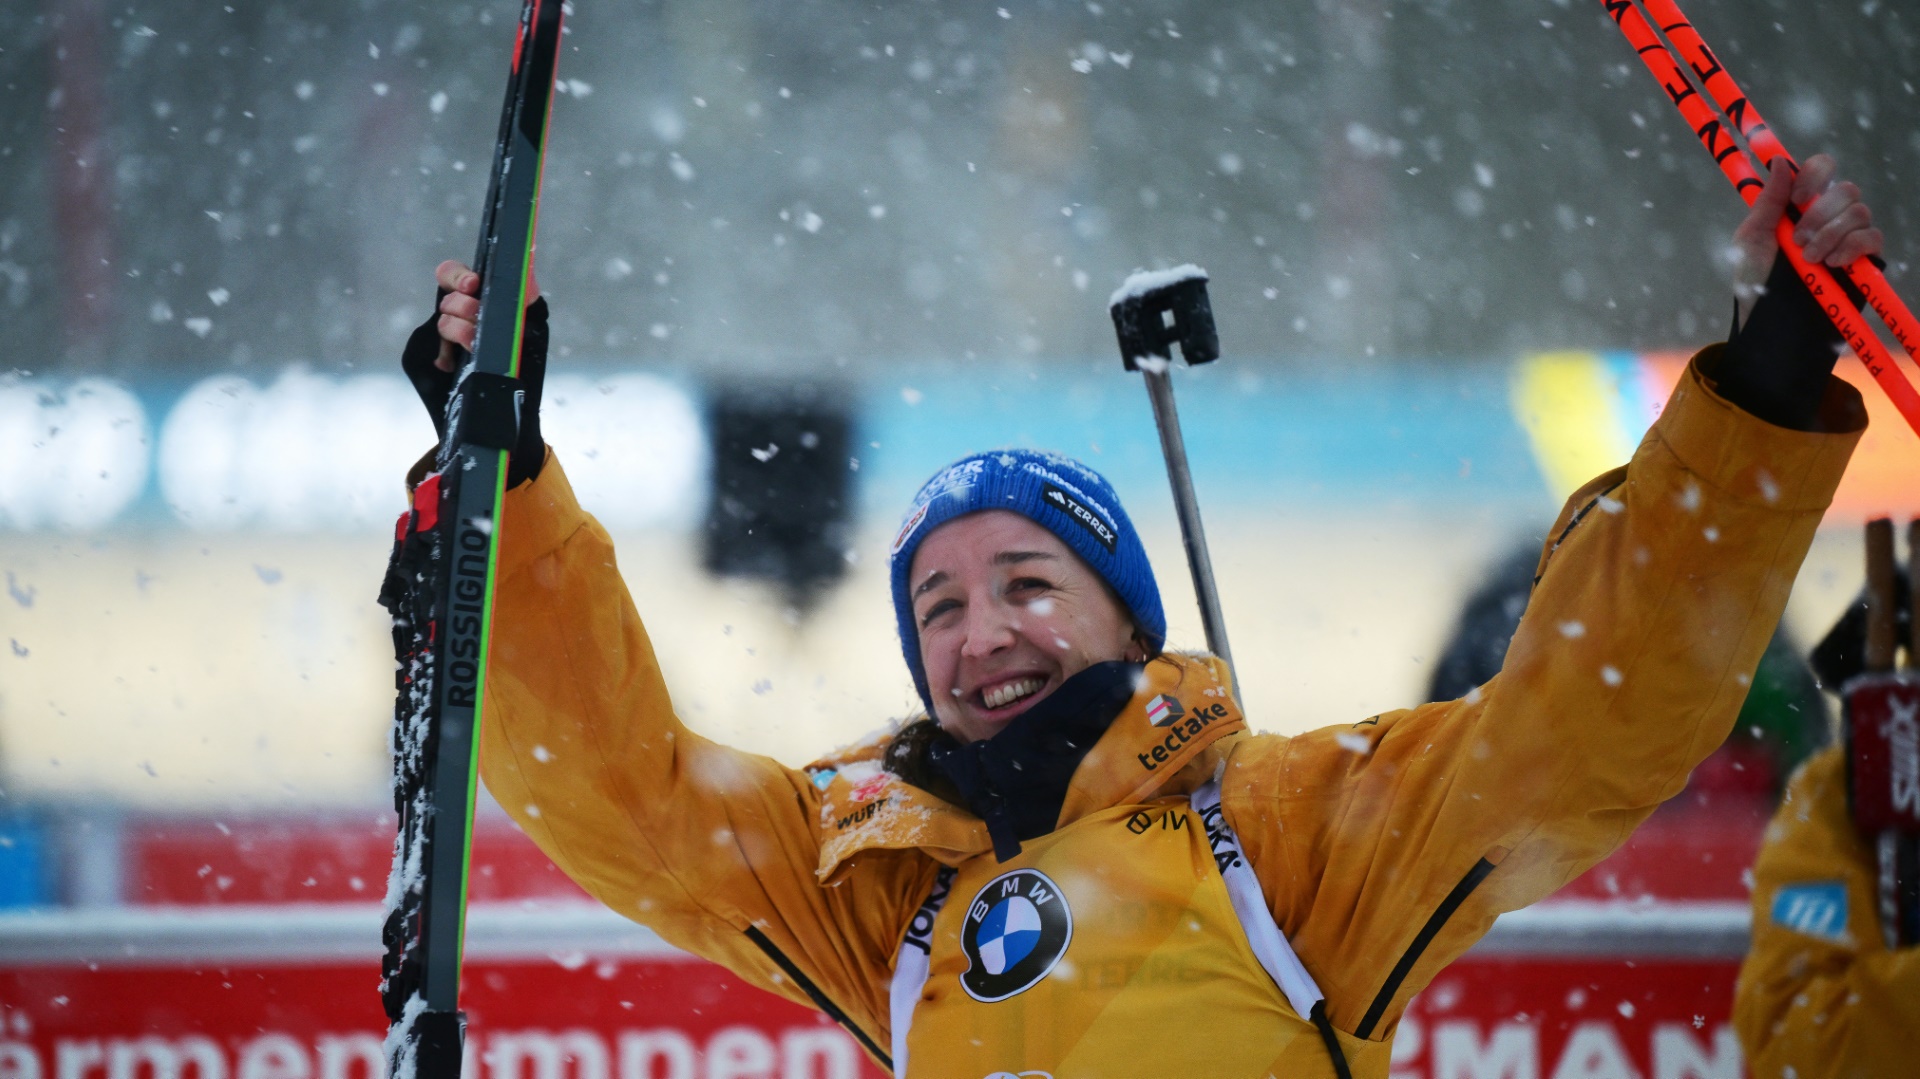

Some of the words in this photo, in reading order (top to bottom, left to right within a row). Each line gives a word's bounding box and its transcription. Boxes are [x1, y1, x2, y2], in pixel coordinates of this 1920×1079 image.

[1804, 273, 1825, 296] 40
[1826, 303, 1884, 377] PREMIO
[1066, 498, 1115, 545] TERREX
[1137, 703, 1229, 771] tectake
[970, 876, 1055, 924] BMW
